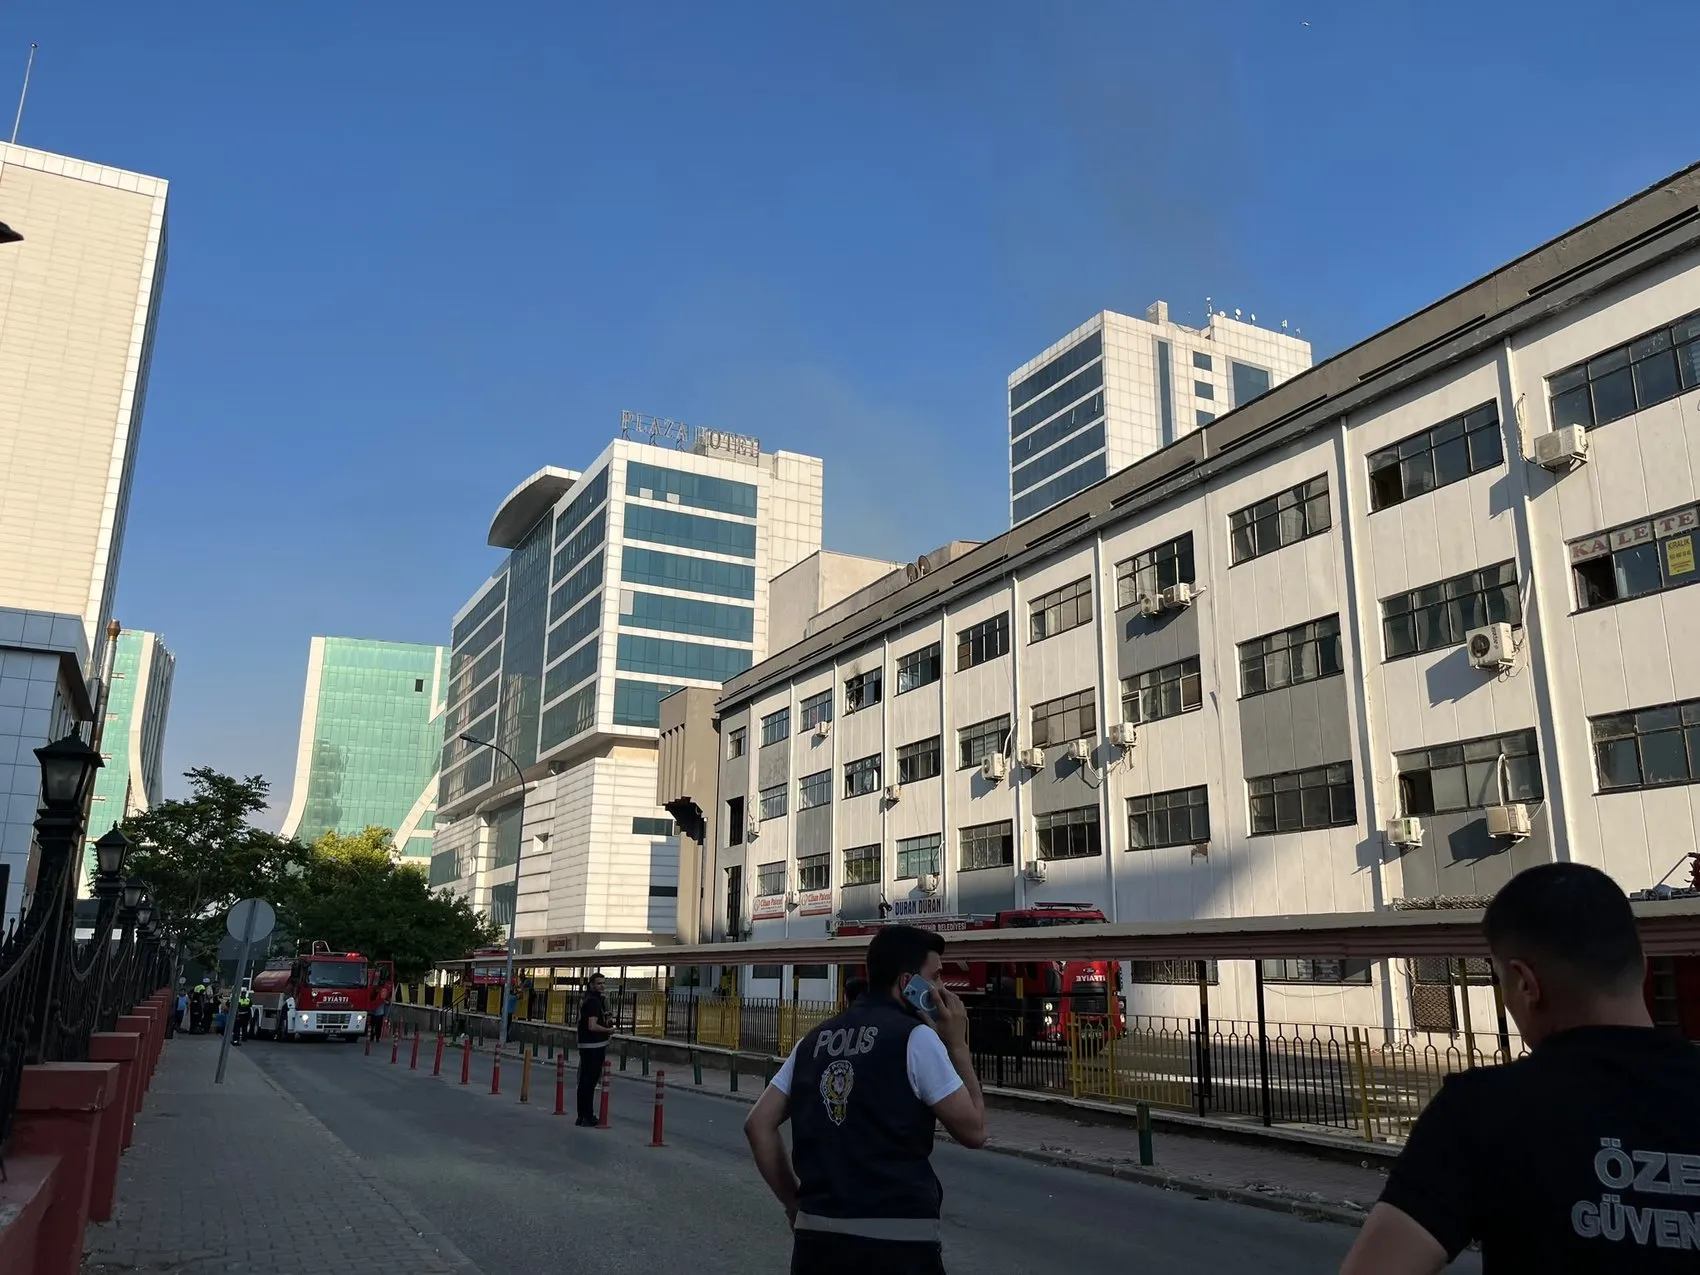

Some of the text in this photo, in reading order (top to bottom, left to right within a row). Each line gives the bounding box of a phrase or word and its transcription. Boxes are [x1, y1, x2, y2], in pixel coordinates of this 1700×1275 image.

[621, 410, 760, 458] PLAZA HOTEL
[895, 899, 941, 915] DURAN DURAN
[1594, 1137, 1700, 1196] ÖZE
